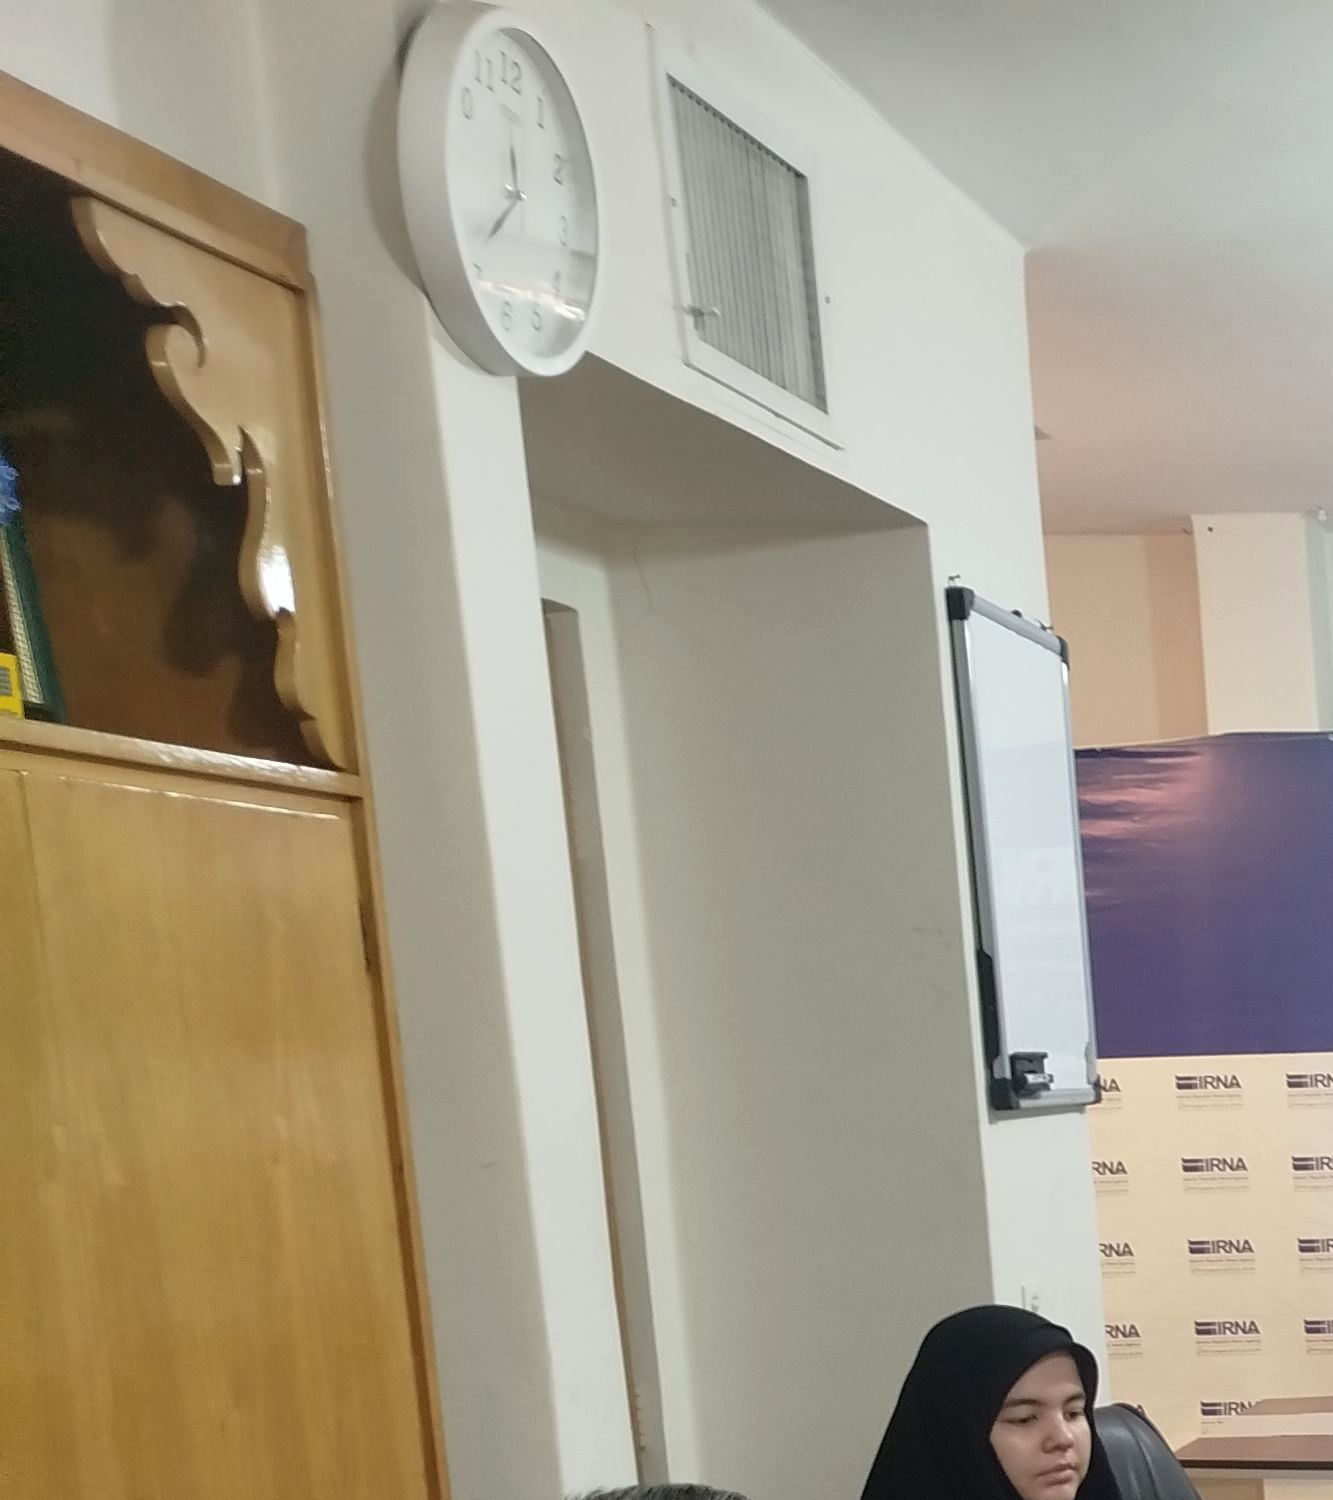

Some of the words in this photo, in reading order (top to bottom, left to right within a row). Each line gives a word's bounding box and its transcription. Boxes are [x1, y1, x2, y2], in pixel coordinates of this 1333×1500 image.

[1198, 1074, 1243, 1090] IRNA
[1092, 1161, 1128, 1176] RNA
[1204, 1156, 1249, 1173] IRNA
[1099, 1243, 1134, 1258] RNA
[1211, 1238, 1255, 1255] IRNA
[1105, 1324, 1141, 1339] RNA
[1217, 1319, 1261, 1336] IRNA
